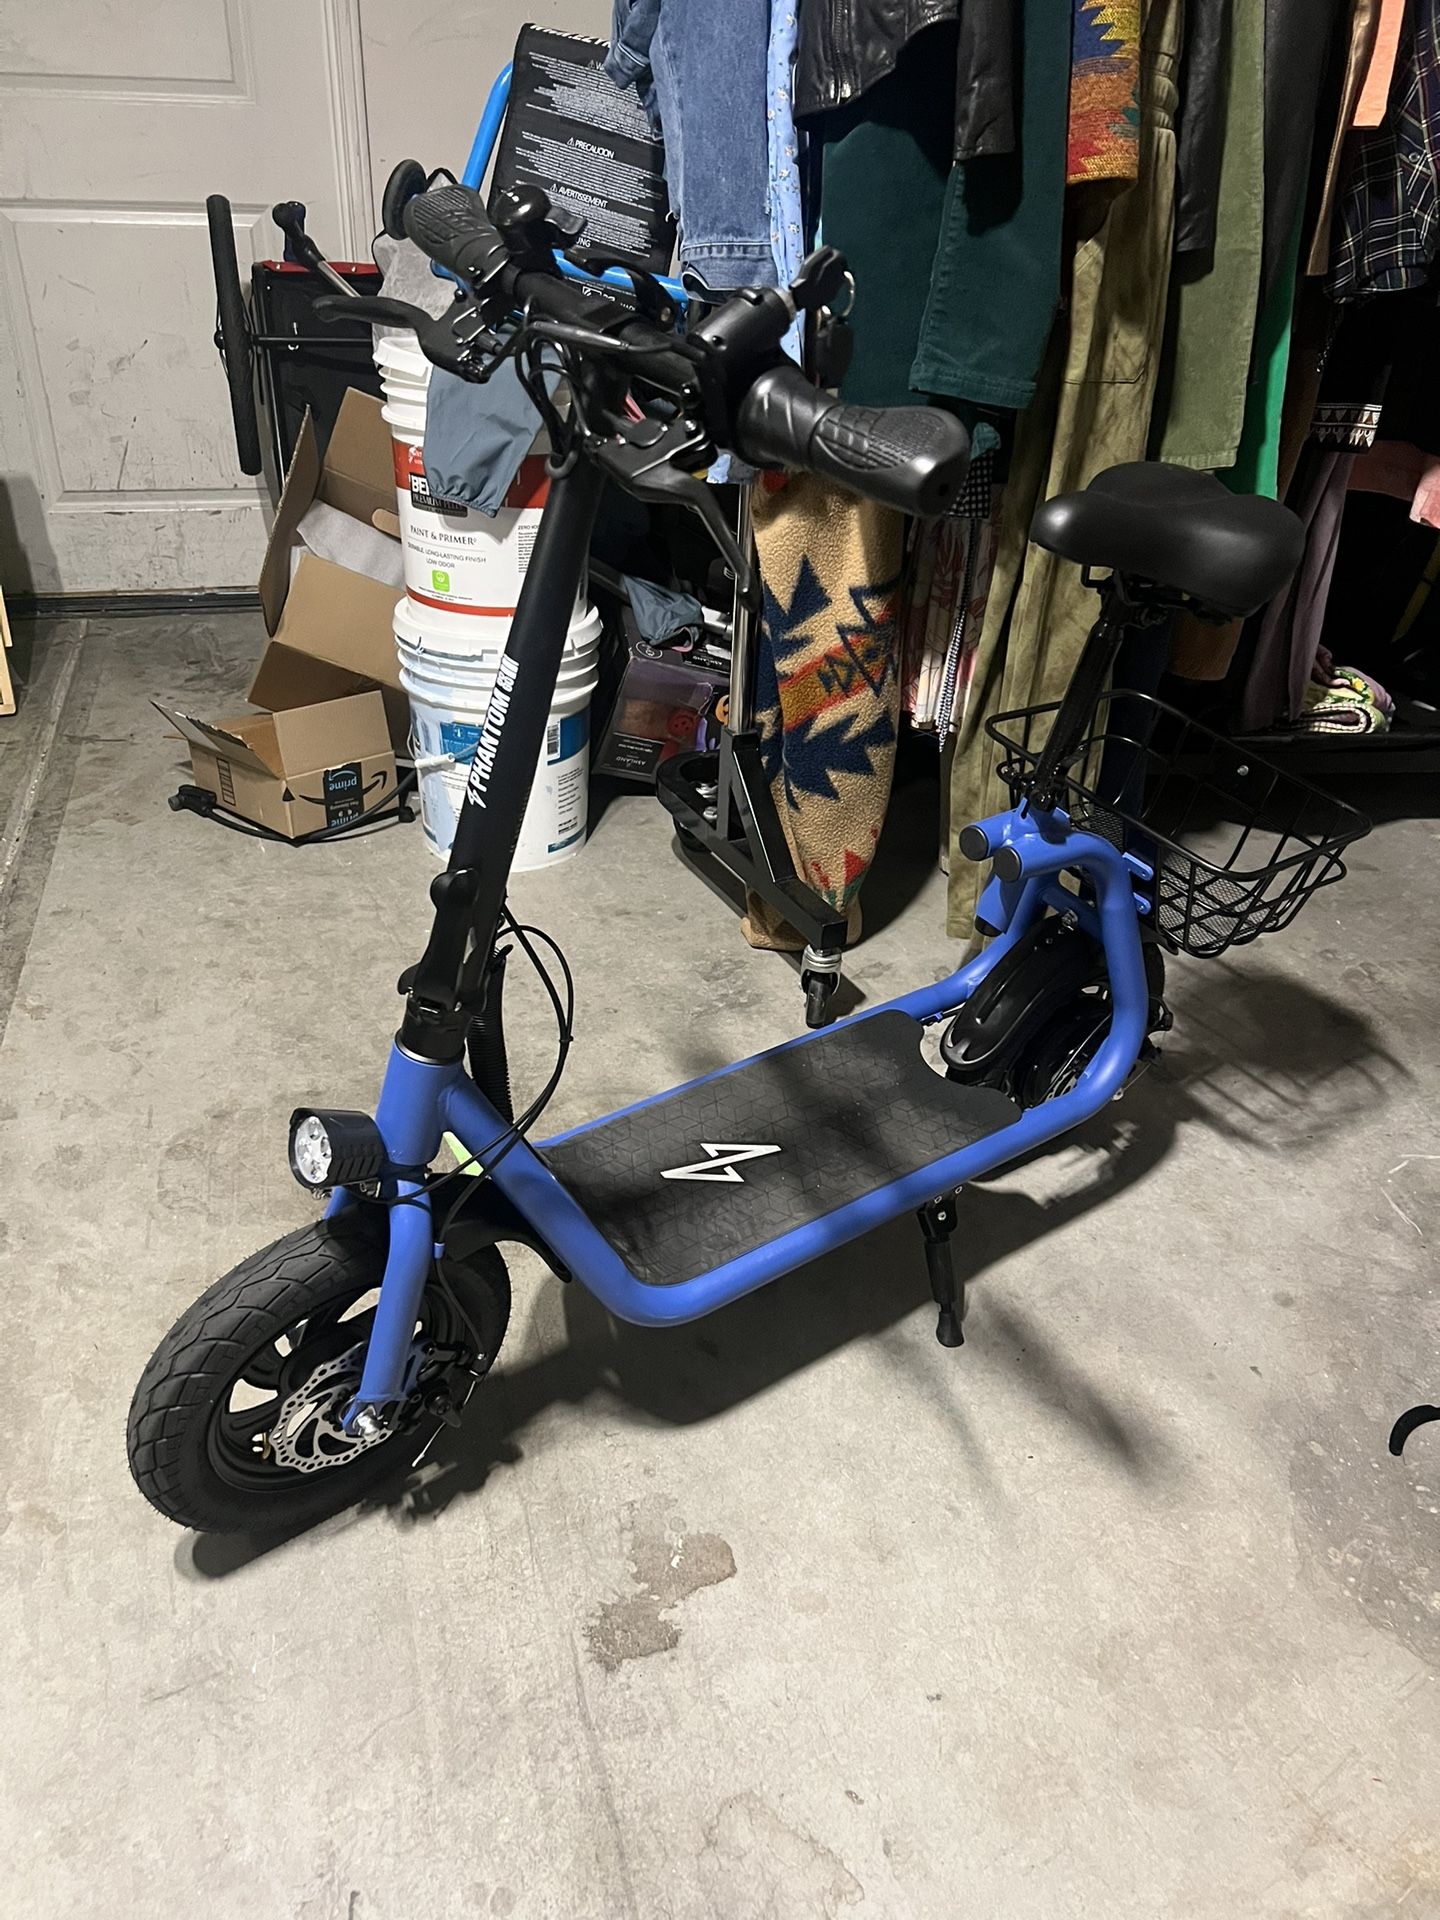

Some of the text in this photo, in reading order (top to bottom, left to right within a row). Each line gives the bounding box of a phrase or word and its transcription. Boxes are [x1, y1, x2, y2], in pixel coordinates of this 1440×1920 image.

[410, 525, 429, 538] PAINT
[438, 560, 455, 569] ODOR
[469, 688, 512, 793] PHANTOM
[328, 776, 358, 791] prime
